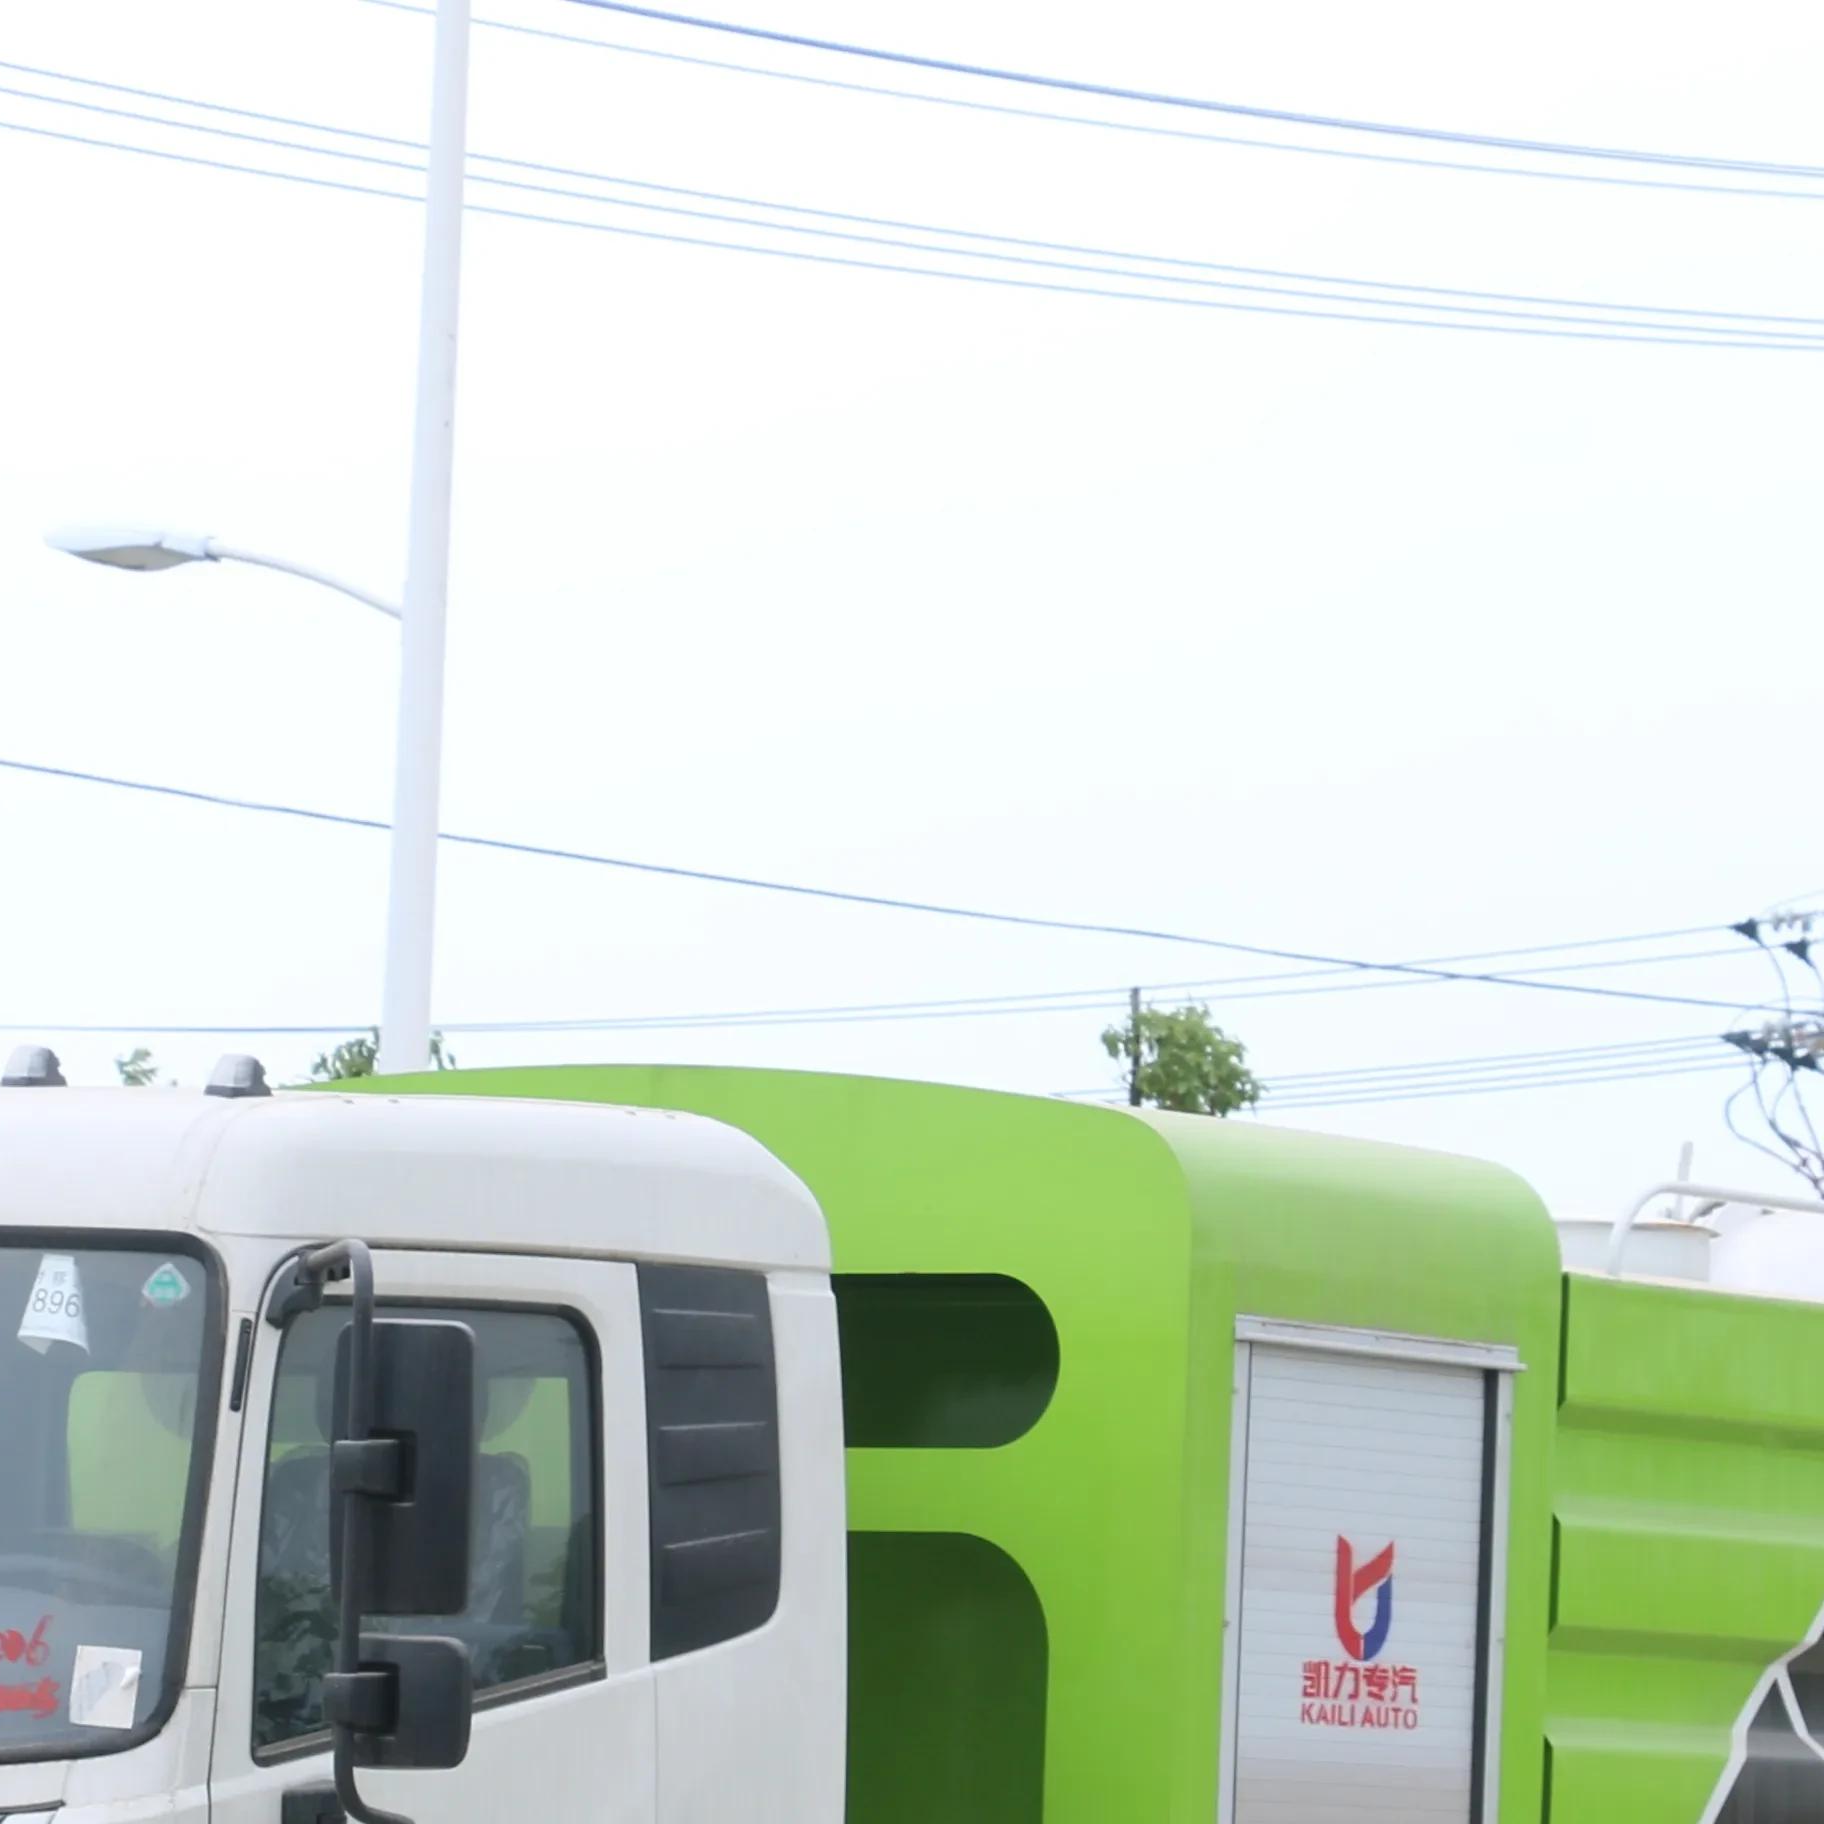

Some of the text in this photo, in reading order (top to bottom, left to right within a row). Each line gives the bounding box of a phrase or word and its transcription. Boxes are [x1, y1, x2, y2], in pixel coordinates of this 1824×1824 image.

[1301, 1660, 1418, 1704] 凯力专汽
[1301, 1703, 1418, 1730] KAILI AUTO
